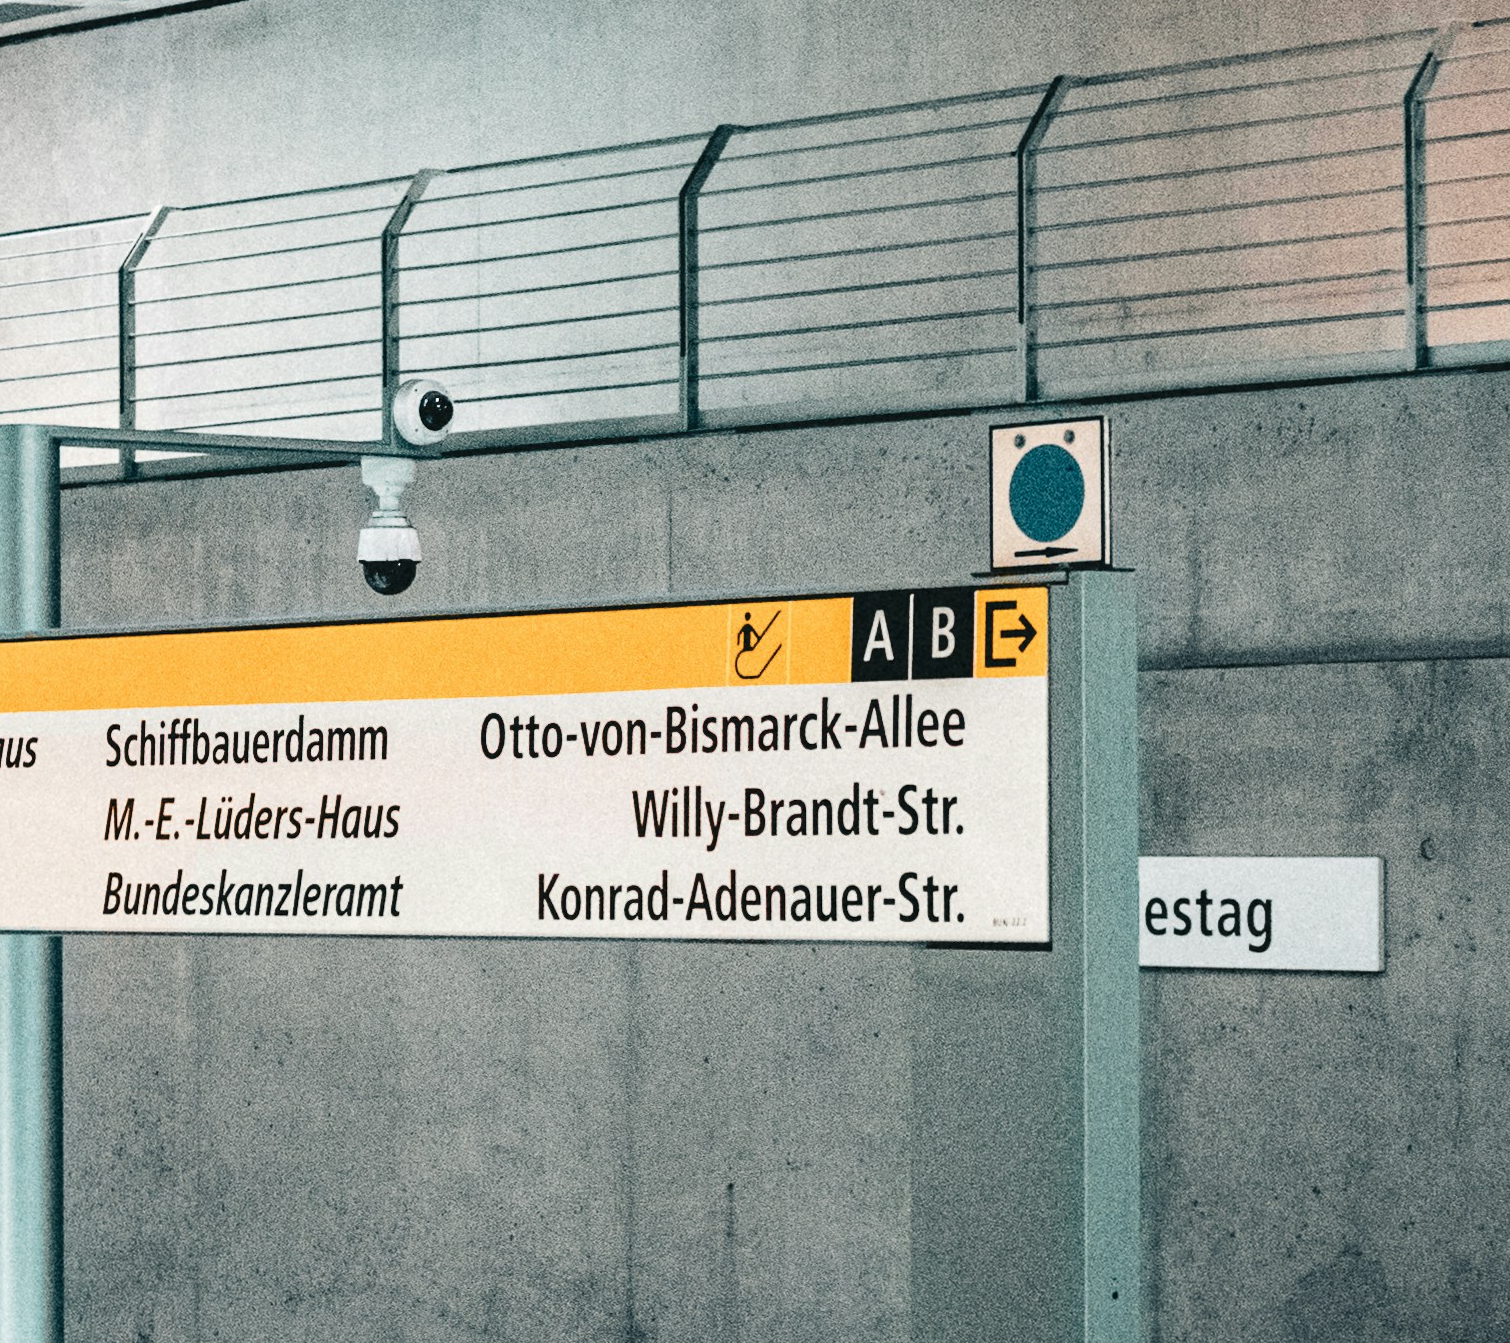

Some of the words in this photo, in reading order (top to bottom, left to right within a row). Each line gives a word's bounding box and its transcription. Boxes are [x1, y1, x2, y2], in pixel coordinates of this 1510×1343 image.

[863, 609, 895, 662] A
[931, 606, 956, 659] B
[106, 714, 388, 768] Schiffbauerdamm
[480, 693, 966, 760] Otto-von-Bismarck-Allee
[104, 792, 401, 841] M.-E.-Lüders-Haus
[632, 781, 964, 852] Willy-Brandt-Str.
[102, 868, 404, 917] Bundeskanzleramt
[538, 869, 965, 923] Konrad-Adenauer-Str.
[1144, 889, 1273, 954] estag
